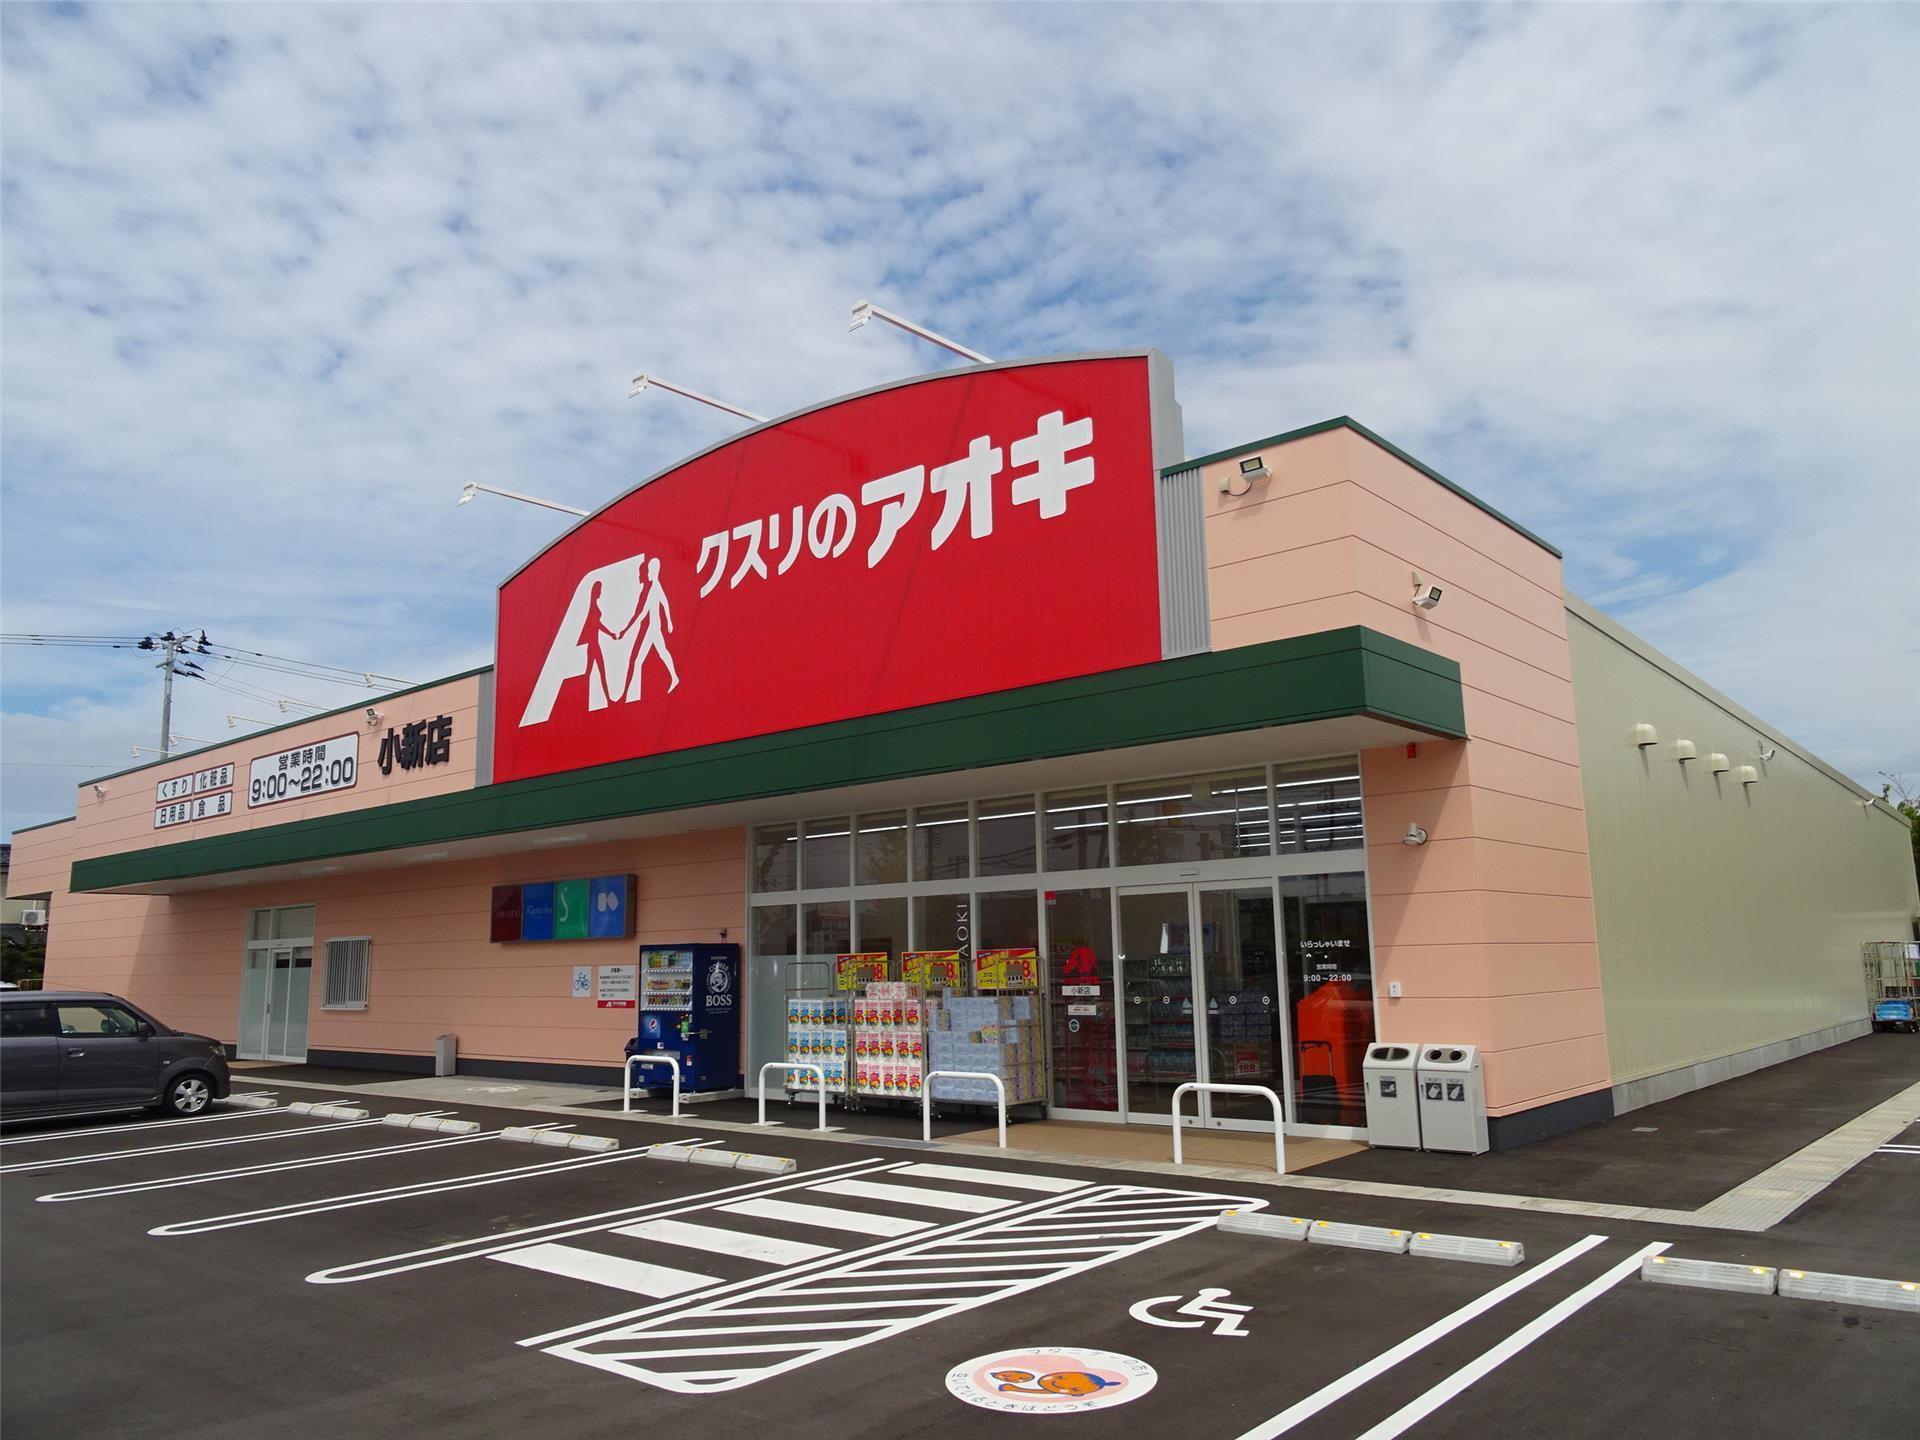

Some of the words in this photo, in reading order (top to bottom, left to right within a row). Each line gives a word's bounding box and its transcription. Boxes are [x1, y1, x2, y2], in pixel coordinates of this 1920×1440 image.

[697, 410, 1095, 599] クスリのアオキ
[377, 715, 452, 775] 小新店
[278, 745, 327, 771] 営業時間
[162, 778, 188, 797] くすり
[200, 767, 228, 789] 化粧品
[160, 804, 185, 824] 日用品
[197, 795, 226, 816] 食品
[957, 904, 969, 957] AOKI
[1300, 939, 1351, 948] いらっしゃいませ
[705, 994, 732, 1006] BOSS
